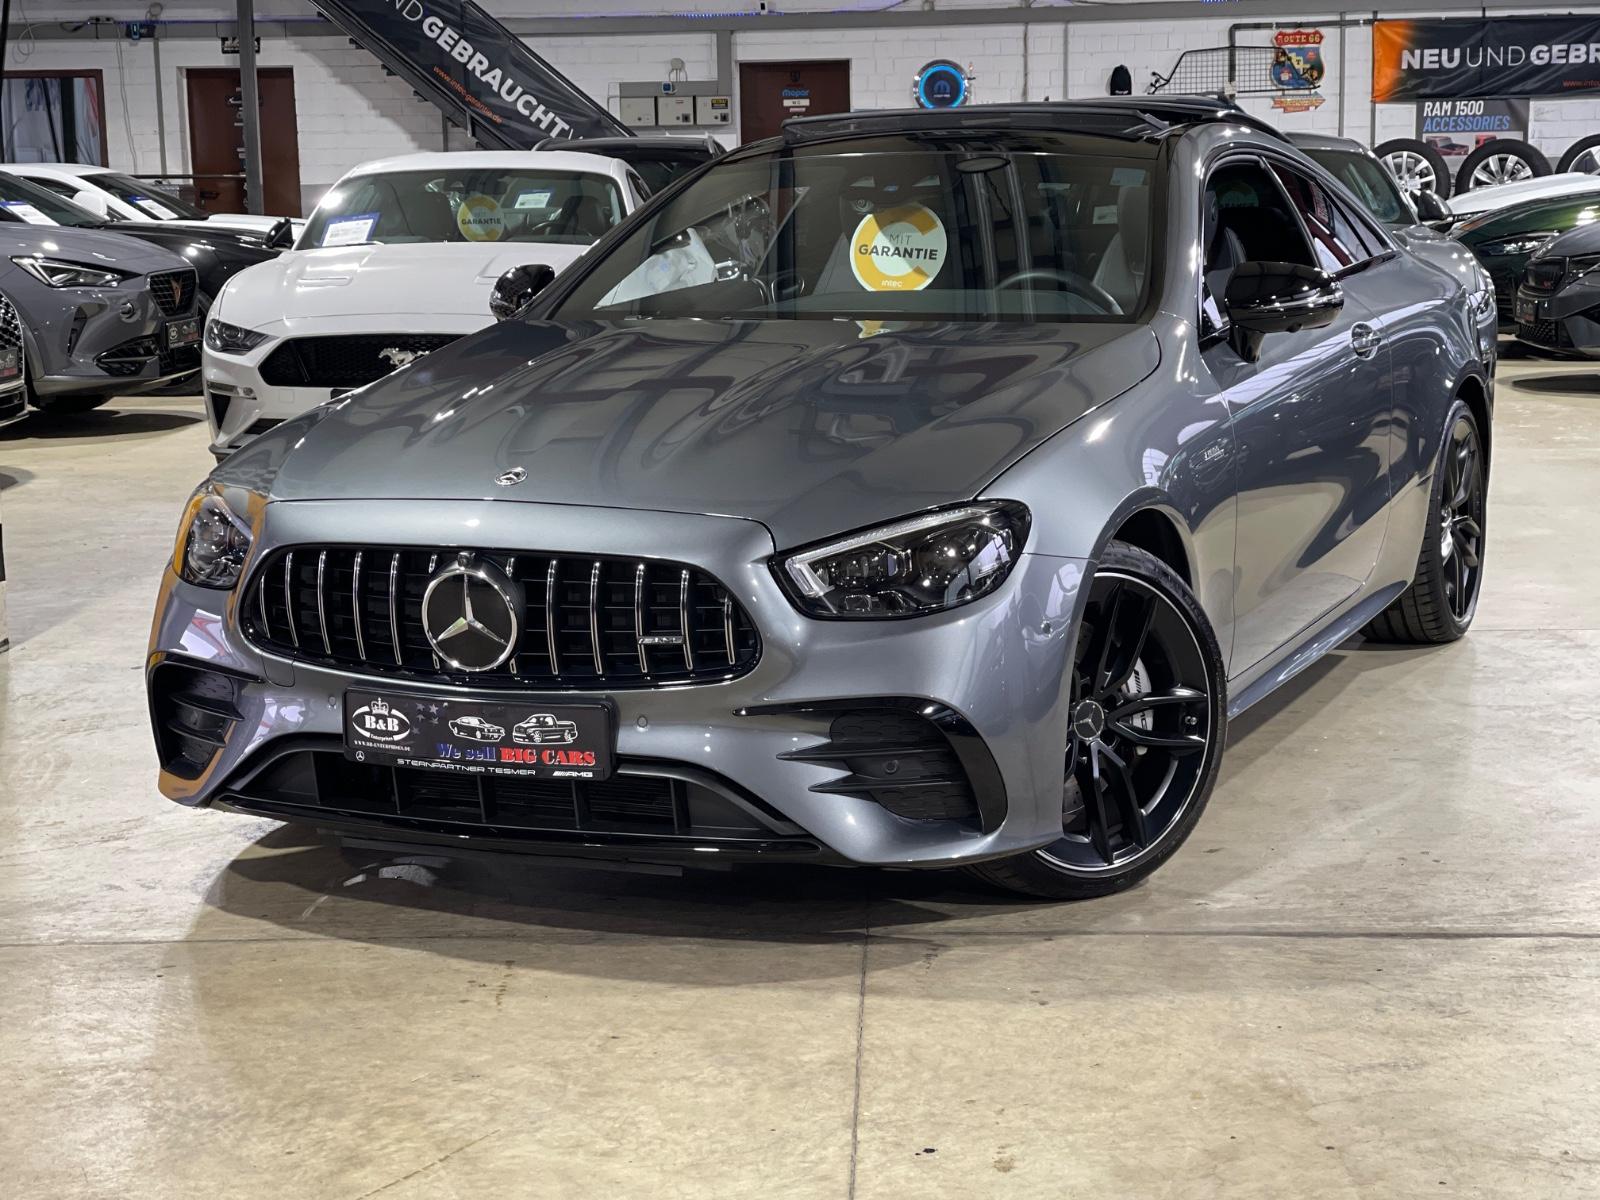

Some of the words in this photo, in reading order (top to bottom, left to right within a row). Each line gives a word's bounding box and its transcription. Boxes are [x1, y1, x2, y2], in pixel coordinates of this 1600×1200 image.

[1277, 35, 1307, 44] ROUTE
[1308, 34, 1320, 42] 66
[1401, 47, 1461, 70] NEU
[1466, 45, 1526, 68] UND
[422, 16, 570, 138] GEBRAUCHT
[1423, 101, 1451, 117] RAM
[1455, 100, 1484, 115] 1500
[1423, 115, 1511, 132] ACCESSORIES
[889, 233, 912, 246] MIT
[858, 244, 938, 261] GARANTIE
[364, 714, 399, 732] B&B
[436, 743, 462, 759] We
[500, 746, 537, 763] BIG
[541, 749, 596, 766] CARS
[396, 758, 485, 773] STERNPARTNER
[487, 767, 536, 775] TESMER
